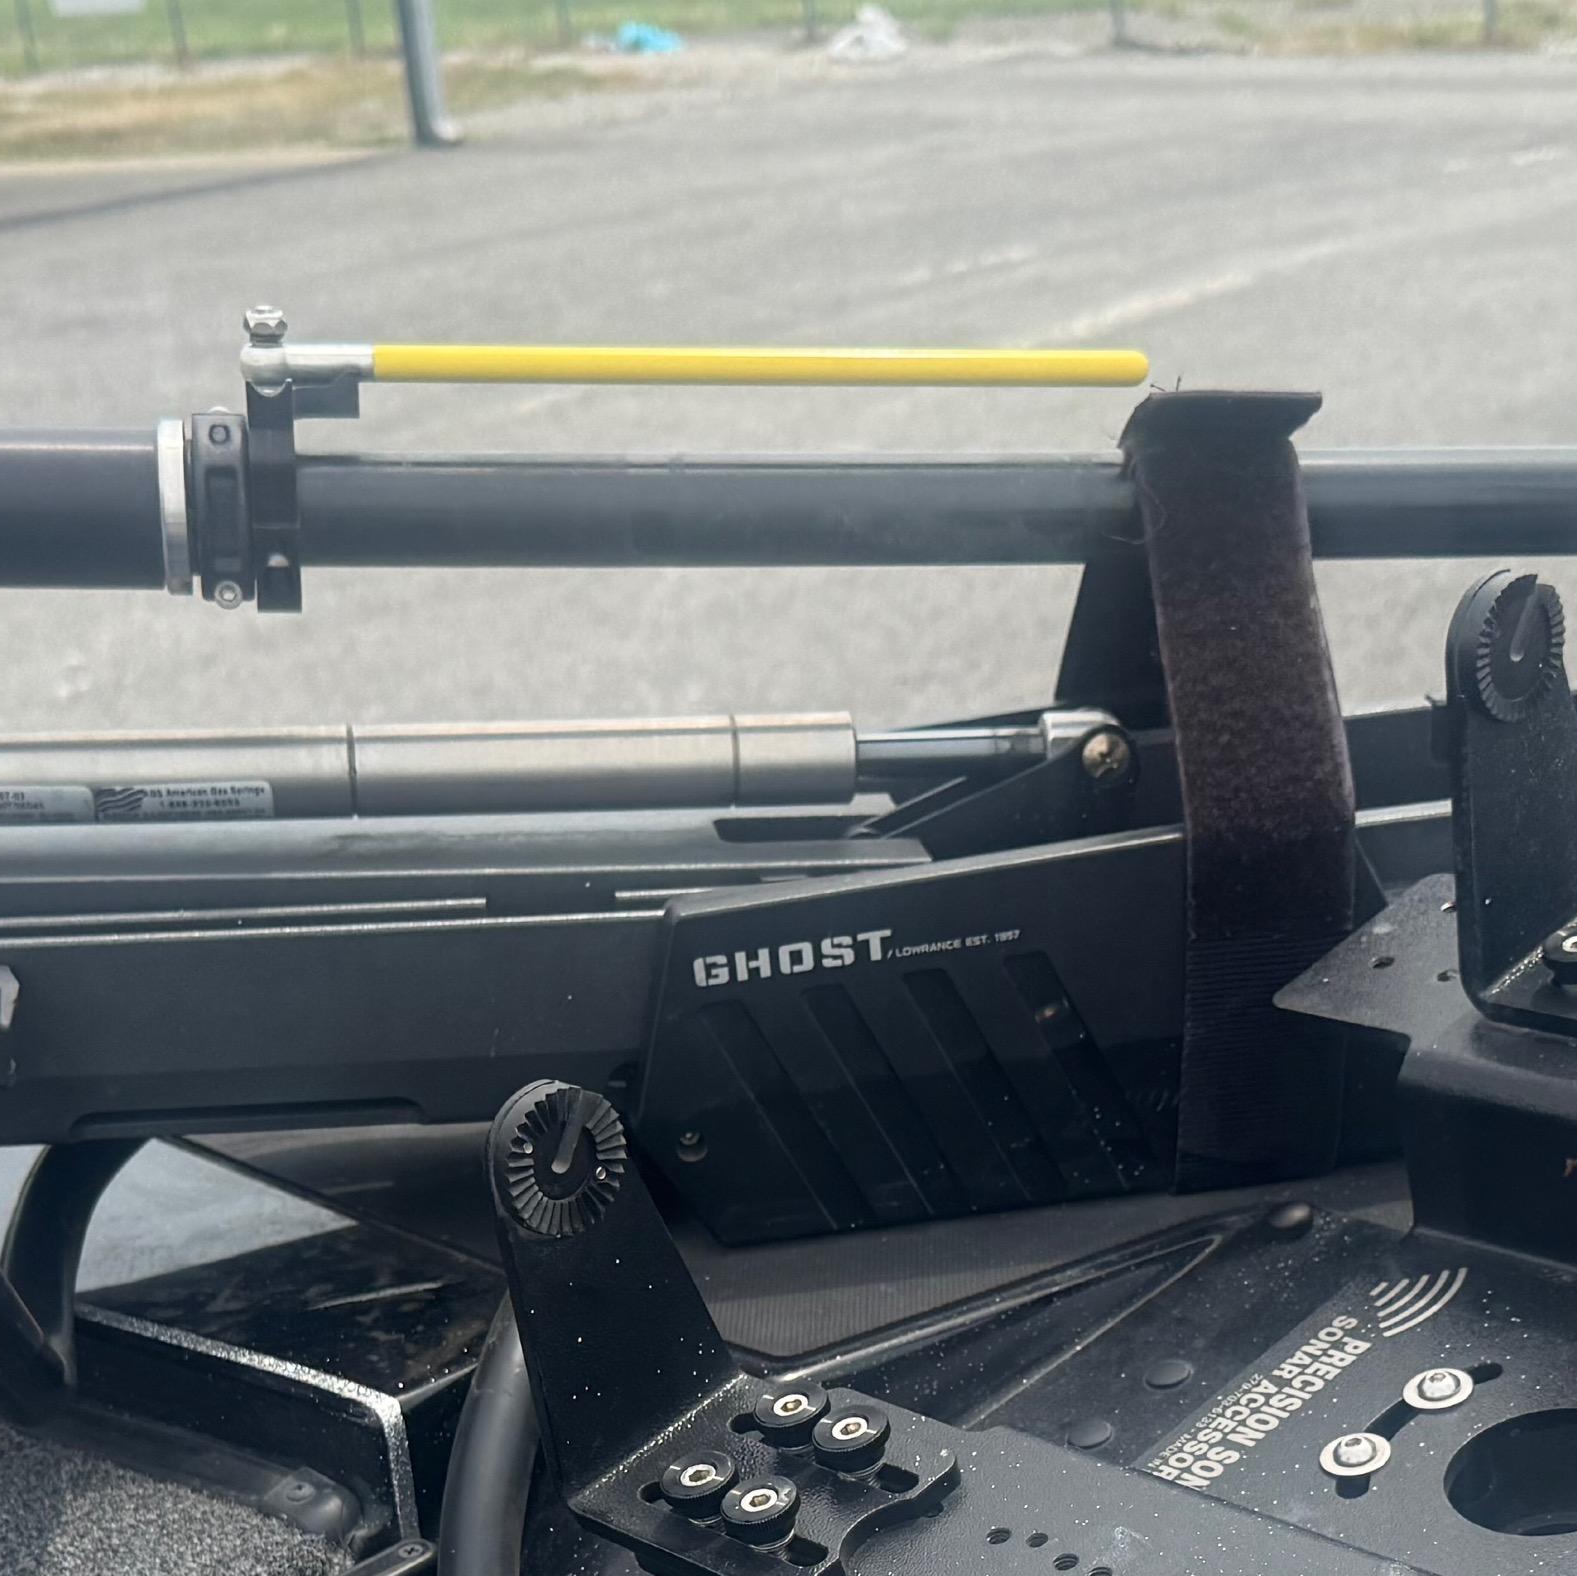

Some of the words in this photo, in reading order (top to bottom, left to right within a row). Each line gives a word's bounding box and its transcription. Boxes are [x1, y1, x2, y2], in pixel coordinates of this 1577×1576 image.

[693, 929, 892, 987] GHOST
[1272, 1315, 1358, 1379] SONAR
[1226, 1335, 1372, 1447] PRECISION
